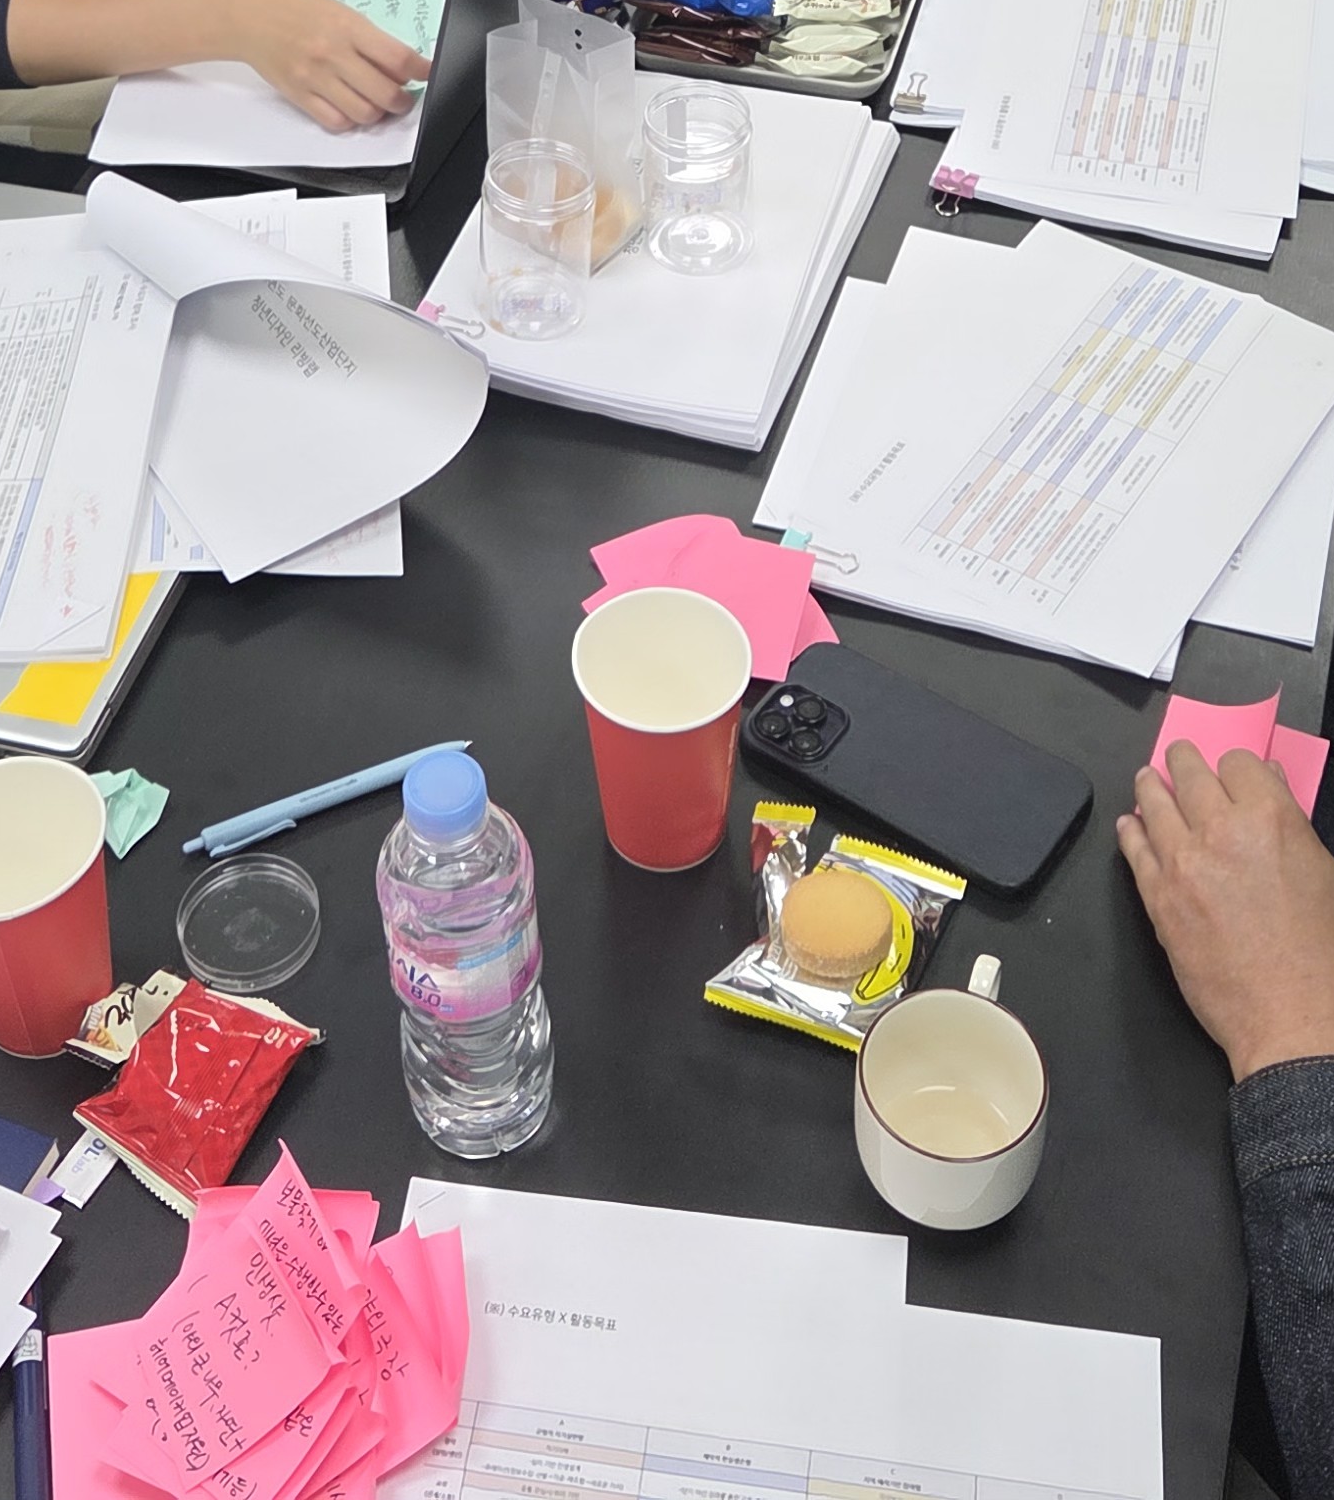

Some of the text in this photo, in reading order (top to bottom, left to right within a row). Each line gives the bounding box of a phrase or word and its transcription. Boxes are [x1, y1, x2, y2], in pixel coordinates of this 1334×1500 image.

[248, 293, 294, 348] 청년디자인
[282, 294, 358, 378] 문화선도산업단지
[411, 985, 441, 1007] 8.0
[506, 1302, 556, 1323] 수요유형
[557, 1311, 567, 1324] X
[569, 1311, 618, 1331] 활동목표
